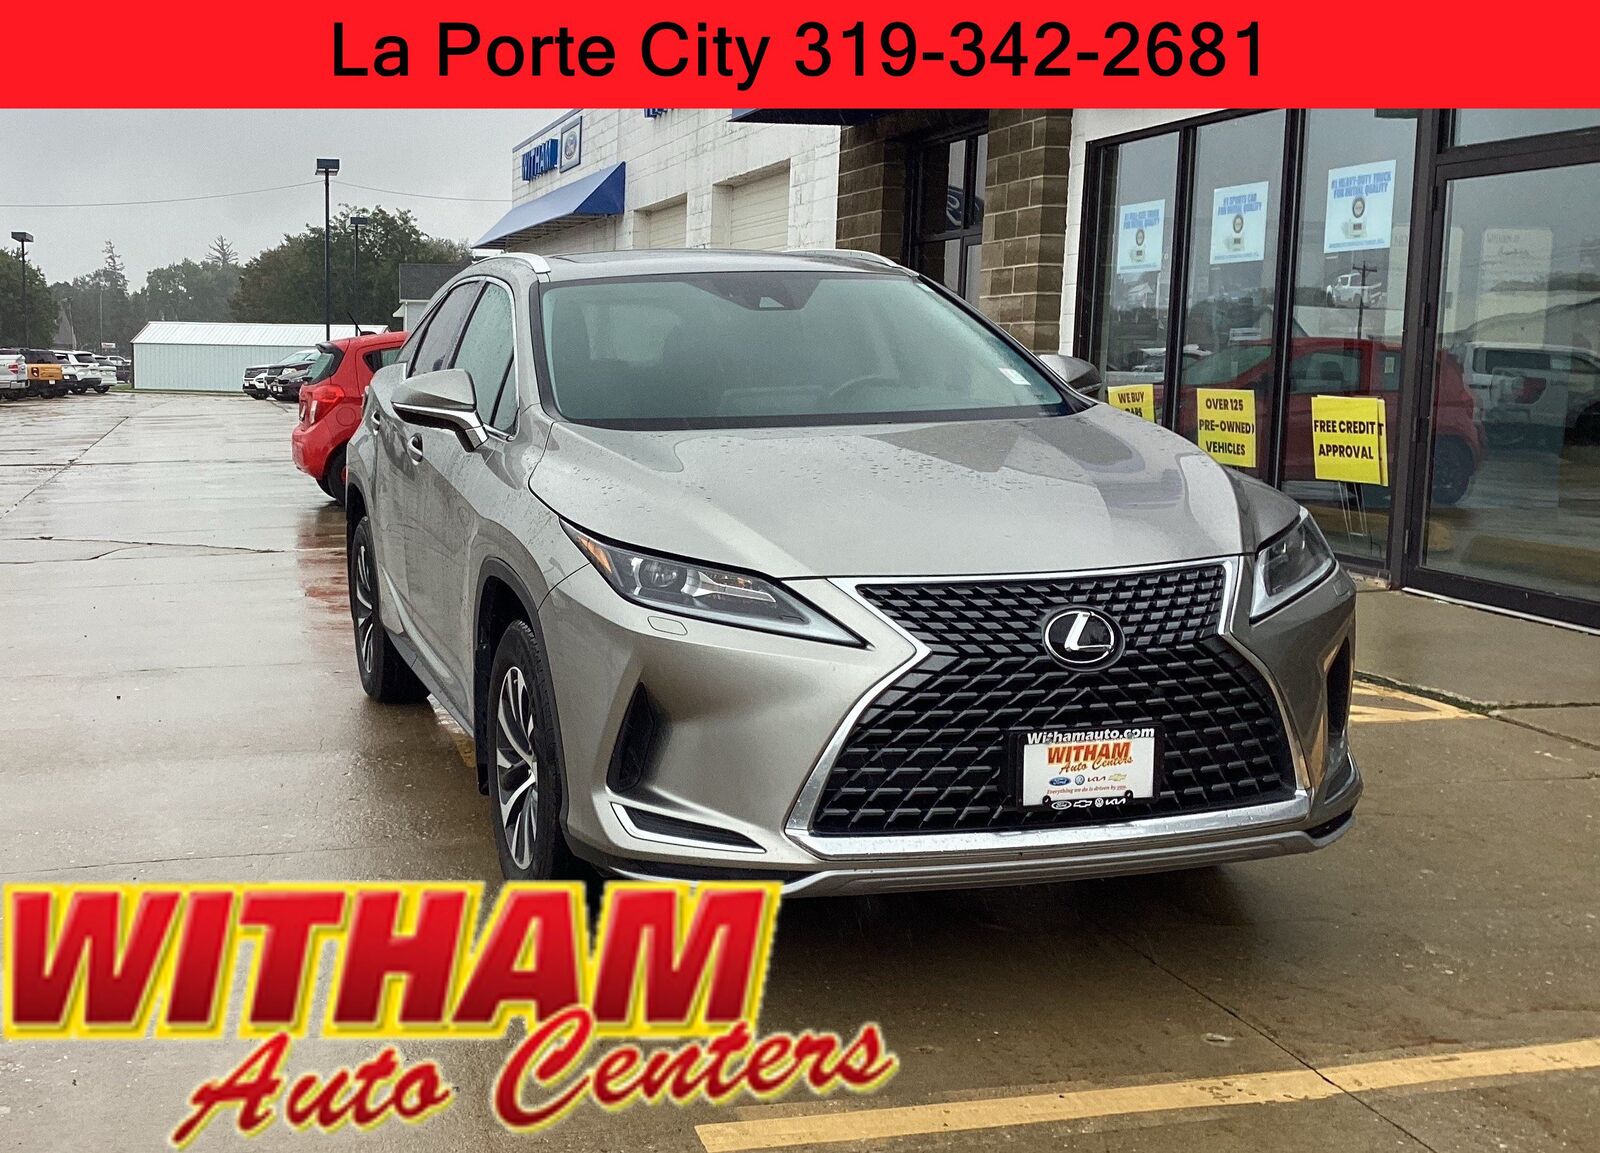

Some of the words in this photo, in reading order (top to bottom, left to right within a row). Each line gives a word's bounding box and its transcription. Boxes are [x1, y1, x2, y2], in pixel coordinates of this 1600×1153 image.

[1118, 393, 1131, 403] WE
[1131, 391, 1145, 403] BUY
[1206, 398, 1229, 410] OVER
[1230, 398, 1244, 411] 125
[1199, 419, 1251, 435] PRE-OWNED
[1314, 420, 1338, 433] FREE
[1339, 421, 1376, 434] CREDIT
[1206, 440, 1246, 455] VEHICLES
[1318, 444, 1374, 459] APPROVAL
[1027, 728, 1154, 745] Withamauto.com
[1047, 741, 1132, 765] WITHAM
[1059, 761, 1087, 775] Auto
[1092, 756, 1134, 770] Centers
